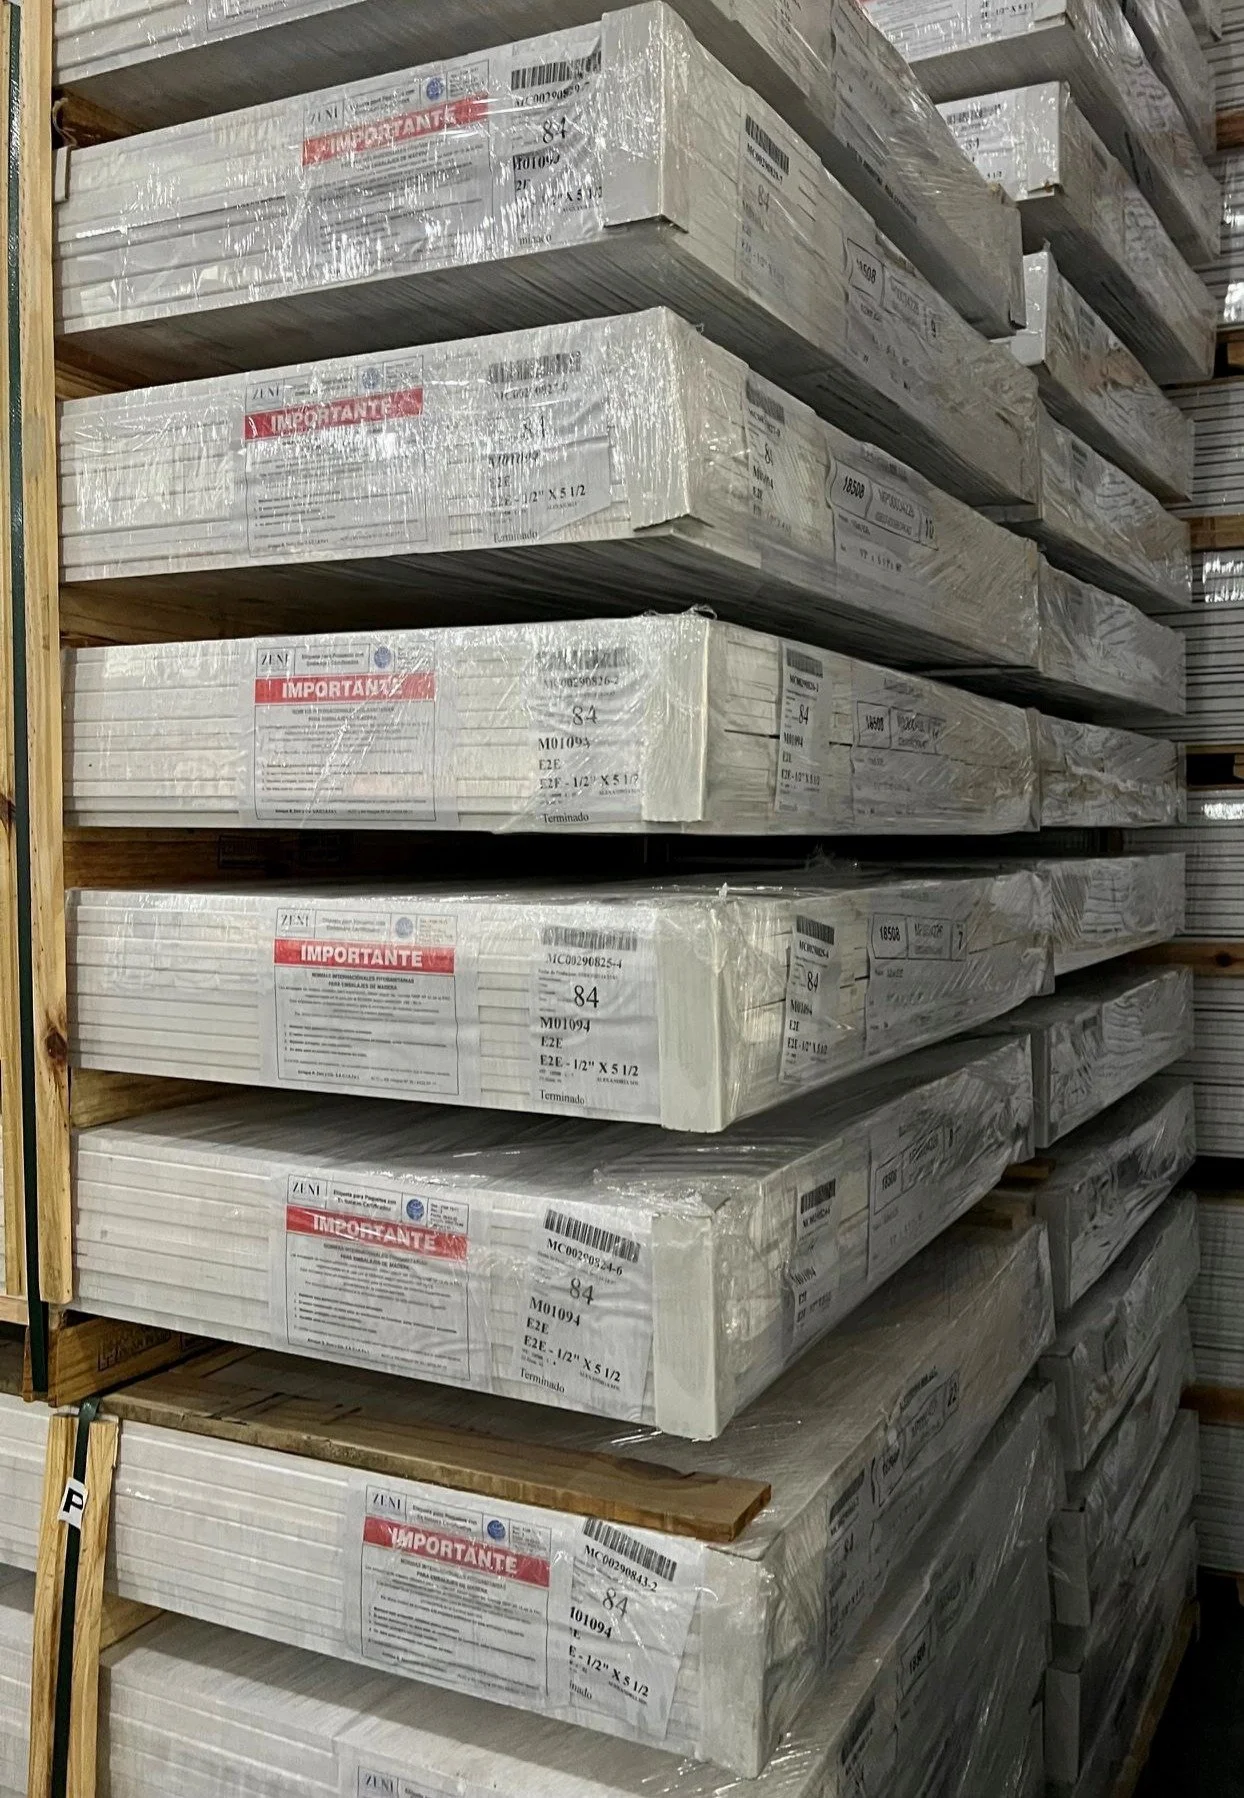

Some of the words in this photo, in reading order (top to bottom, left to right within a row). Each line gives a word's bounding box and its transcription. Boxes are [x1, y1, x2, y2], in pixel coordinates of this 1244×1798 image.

[330, 108, 457, 153] IMPORTANTE
[542, 116, 568, 143] 84
[270, 400, 392, 434] IMPORTANTE
[549, 489, 557, 500] X
[570, 484, 585, 497] 1/2
[843, 476, 865, 499] 18508
[261, 653, 289, 666] ZENI
[282, 677, 402, 699] IMPORTANTE
[572, 704, 598, 726] 84
[798, 704, 809, 725] 84
[538, 737, 591, 750] M01094
[539, 759, 561, 770] E2E
[601, 774, 609, 785] X
[543, 812, 589, 823] Terminado
[281, 914, 309, 927] ZENI
[880, 926, 900, 941] 18508
[301, 945, 423, 968] IMPORTANTE
[546, 953, 623, 969] MC00290825-4
[807, 971, 819, 993] 84
[574, 984, 599, 1009] 84
[540, 1016, 590, 1033] M01094
[541, 1035, 563, 1049] E2E
[540, 1054, 563, 1067] E2E
[574, 1058, 595, 1071] 1/2"
[599, 1062, 607, 1073] X
[623, 1064, 638, 1077] 1/2
[540, 1089, 585, 1105] Terminado
[292, 1181, 320, 1196] ZENI
[312, 1213, 436, 1251] IMPORTANTE
[547, 1238, 623, 1277] MC00290824-6
[569, 1277, 595, 1306] 84
[530, 1296, 581, 1327] M01094
[527, 1316, 549, 1335] E2E
[524, 1334, 547, 1353] E2E
[557, 1348, 580, 1363] 1/2"
[583, 1357, 591, 1371] X
[594, 1363, 601, 1375] 5
[605, 1367, 621, 1382] 1/2
[520, 1367, 565, 1393] Terminado
[62, 1487, 83, 1513] P
[373, 1492, 400, 1510] ZENI
[391, 1527, 517, 1574] IMPORTANTE
[584, 1544, 659, 1593] MC00290843-2
[602, 1586, 628, 1619] 84
[570, 1605, 612, 1638] 01094
[587, 1654, 609, 1672] 1/2"
[612, 1667, 620, 1682] X
[634, 1680, 649, 1697] 1/2
